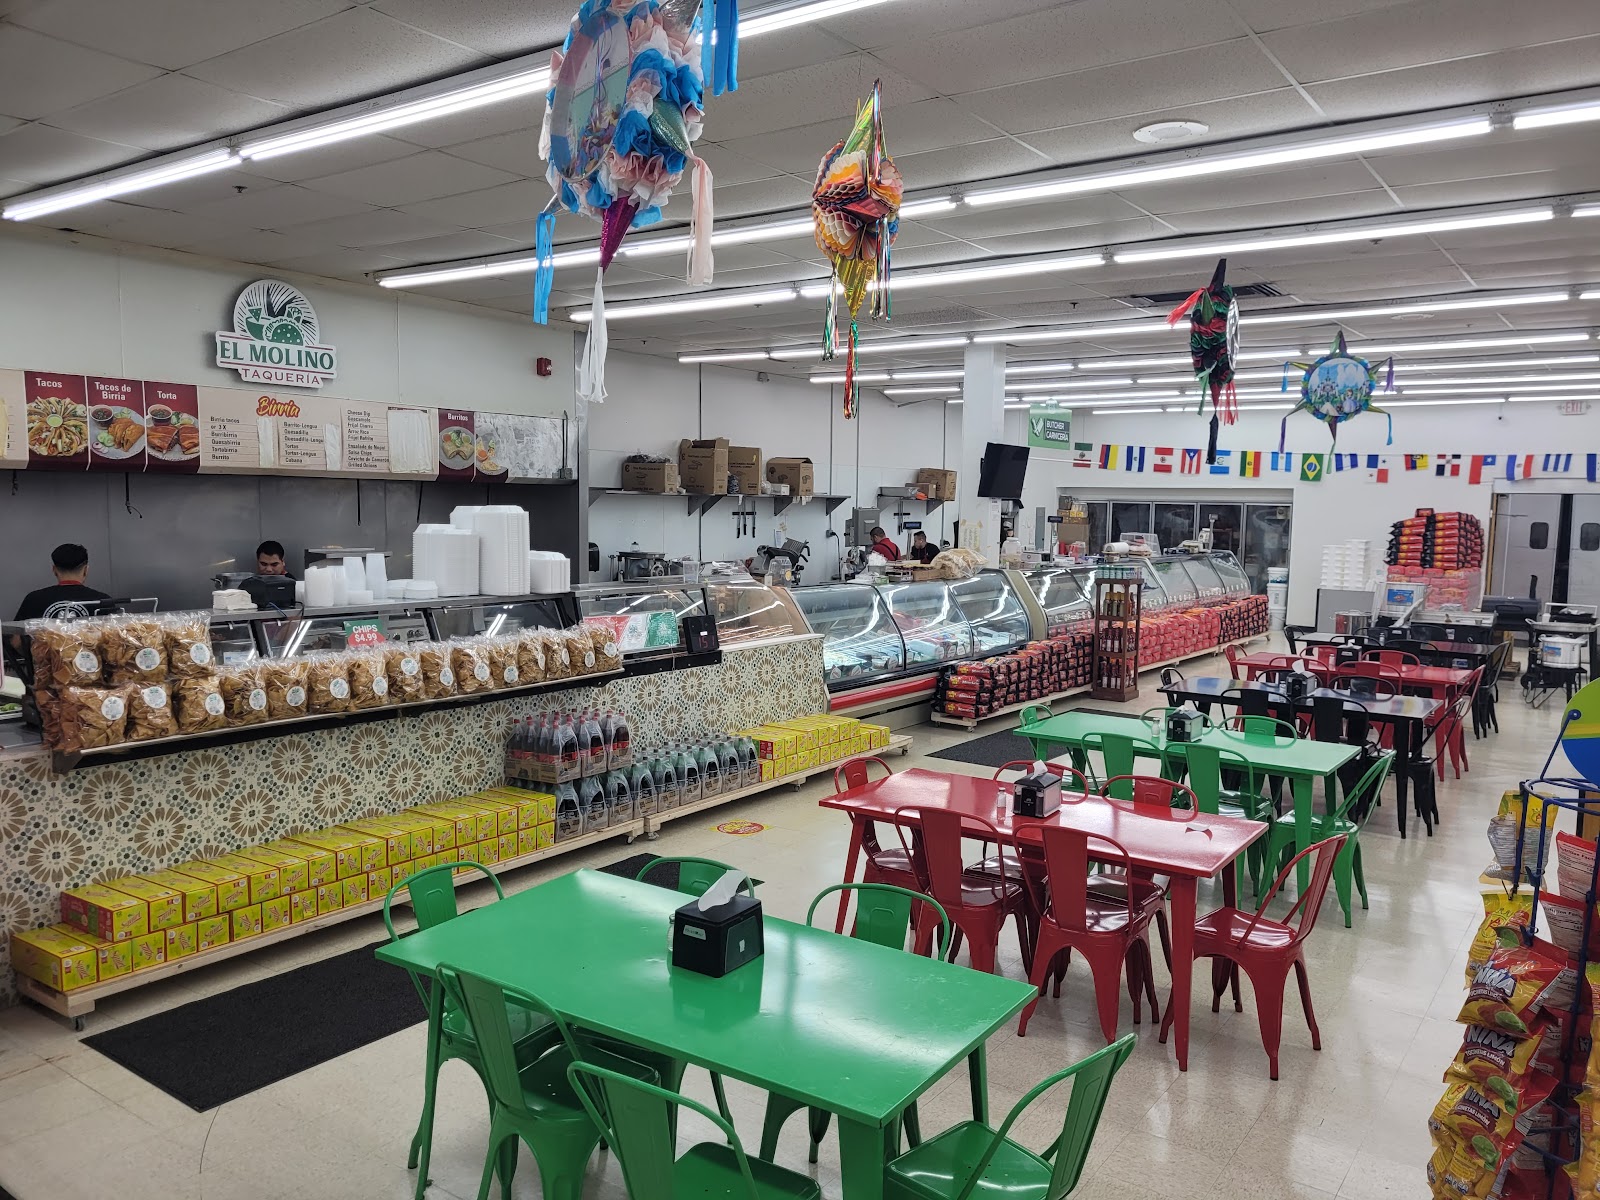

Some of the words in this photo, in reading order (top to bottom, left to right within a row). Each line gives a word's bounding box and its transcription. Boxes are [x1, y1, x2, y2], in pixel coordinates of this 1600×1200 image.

[219, 339, 245, 361] EL
[249, 343, 334, 370] MOLINO
[35, 377, 63, 388] Tacos
[241, 368, 321, 386] TAQUERÍA
[94, 381, 120, 392] Tacos
[121, 384, 131, 393] de
[102, 392, 126, 401] Birria
[156, 390, 177, 400] Torta
[257, 396, 300, 419] Birria
[1565, 401, 1583, 413] EXIT
[447, 412, 469, 422] Burritos
[1046, 420, 1065, 430] BUTCHER
[353, 624, 378, 634] CHIPS
[354, 633, 378, 643] $4.99
[192, 894, 211, 910] Squirt
[1466, 1024, 1516, 1058] NINA
